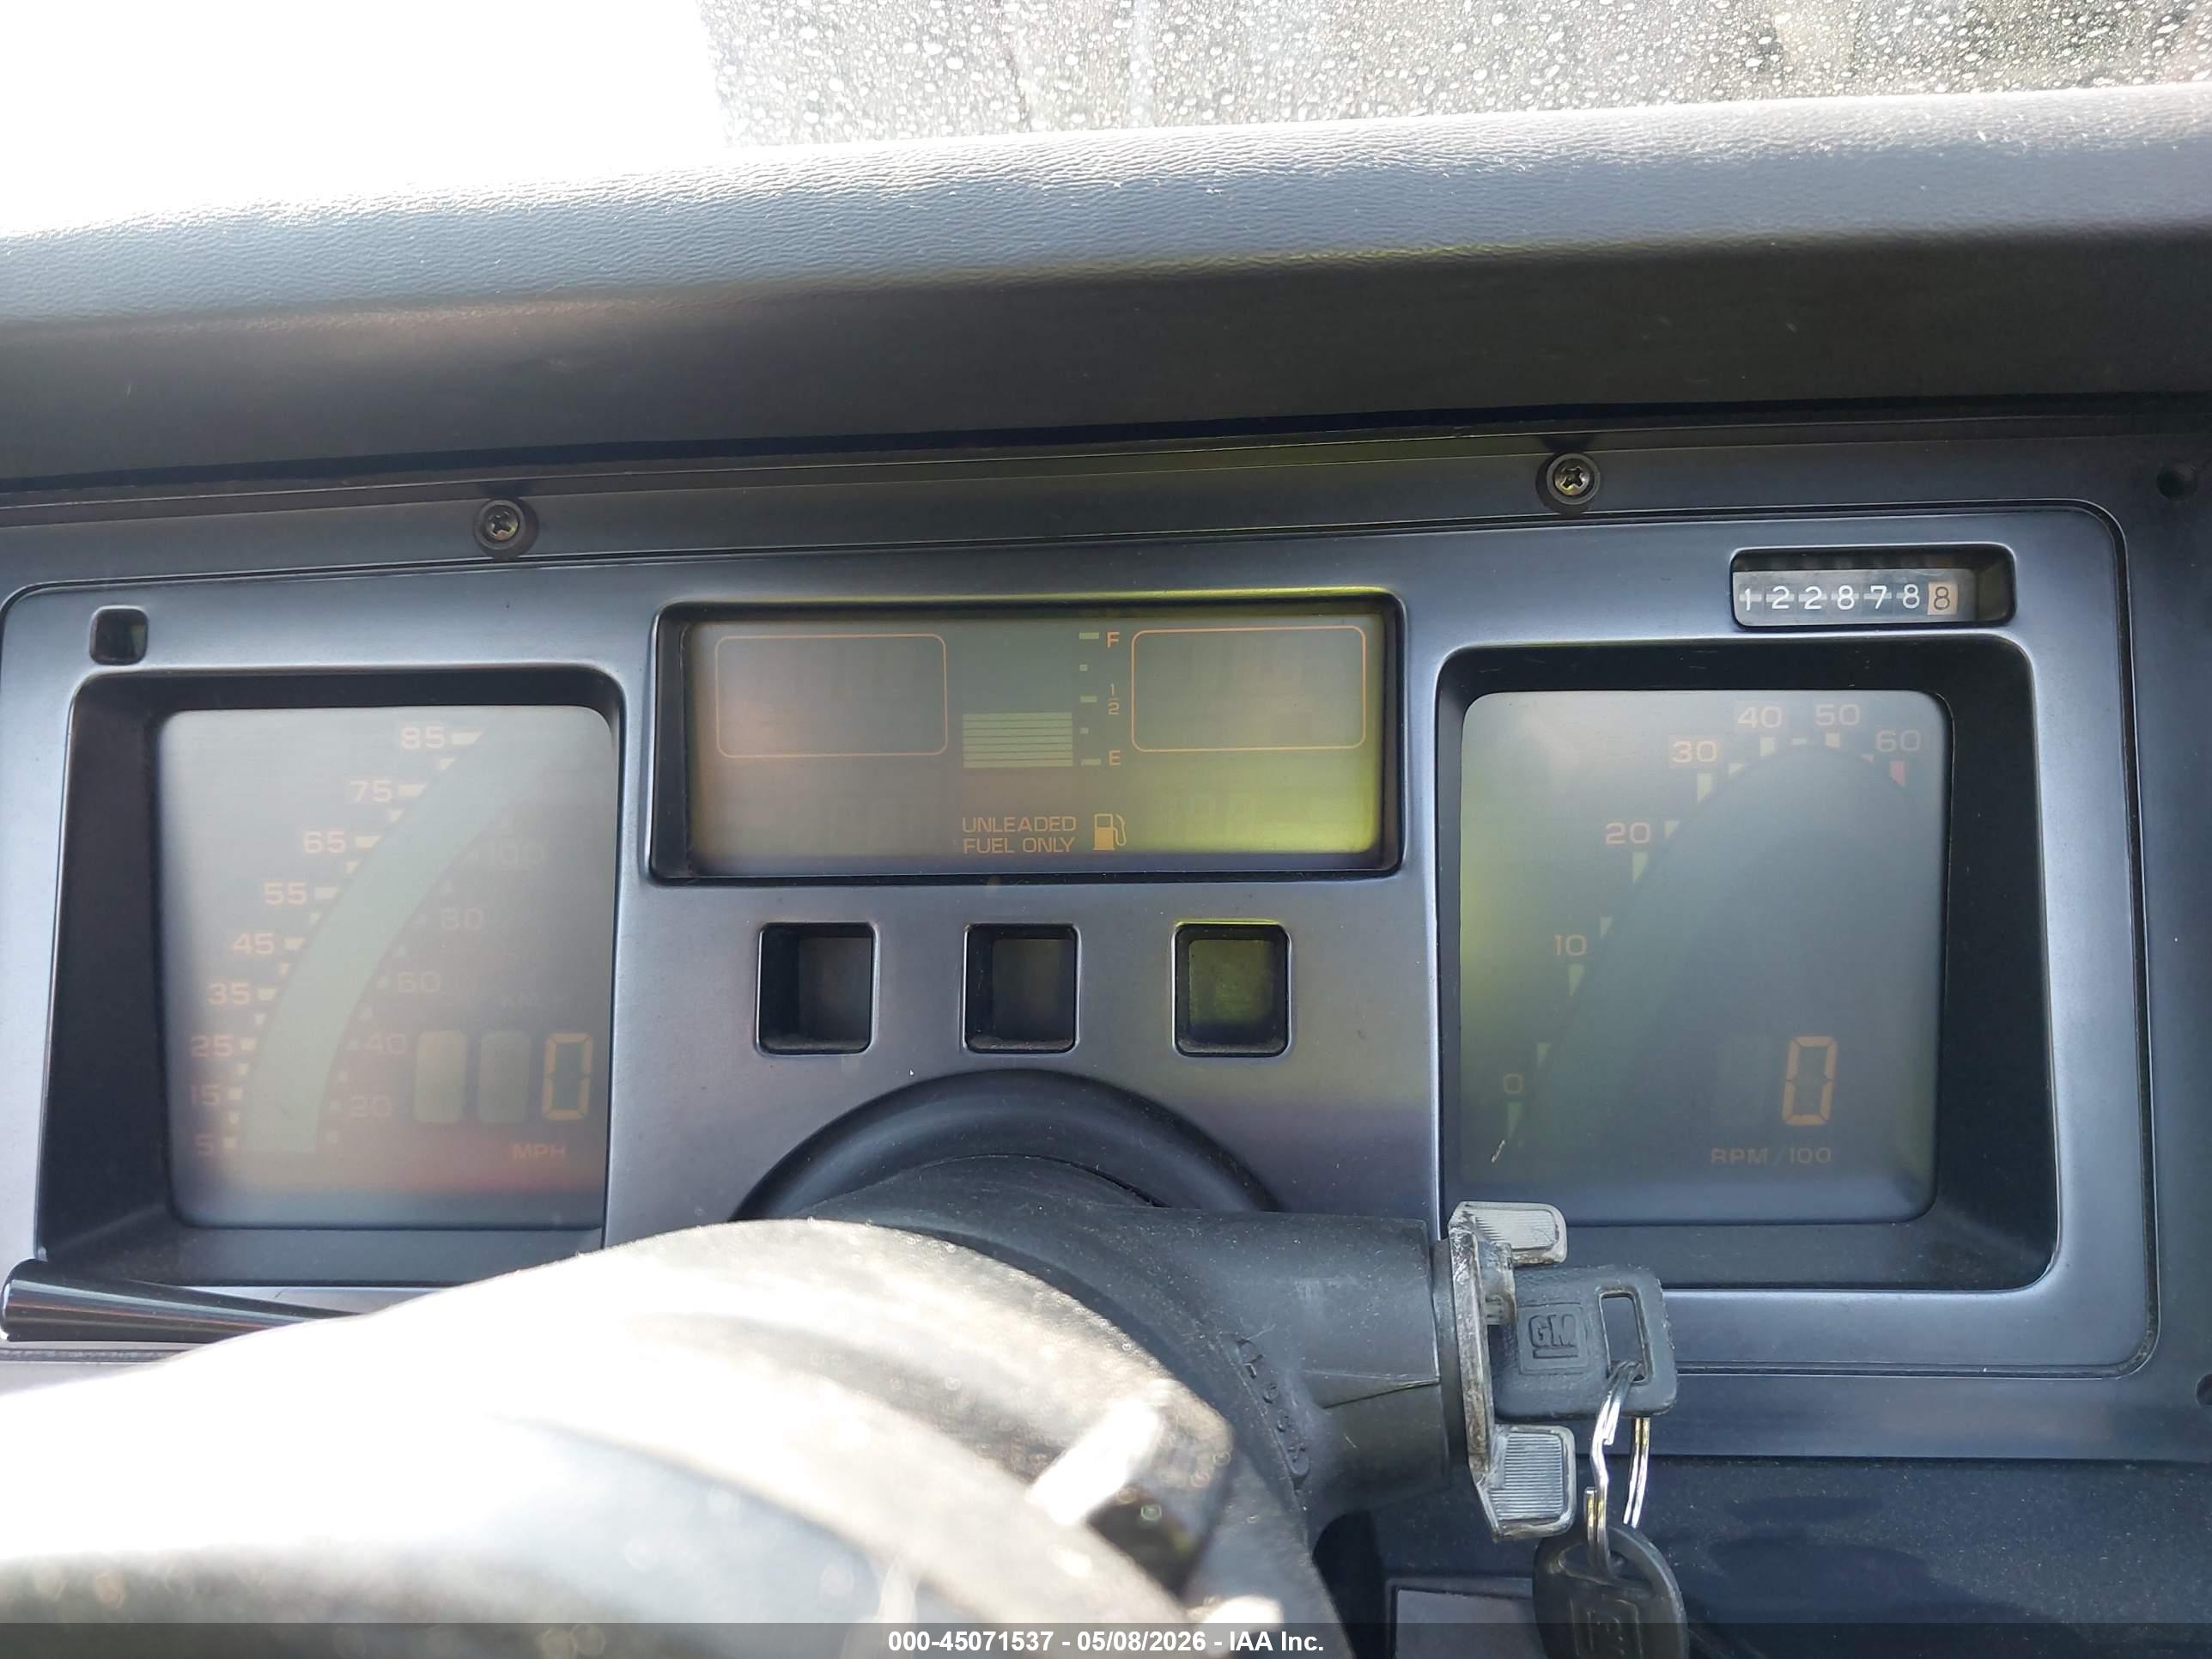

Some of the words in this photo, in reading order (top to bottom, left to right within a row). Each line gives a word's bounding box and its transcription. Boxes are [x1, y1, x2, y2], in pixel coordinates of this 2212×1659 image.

[1106, 631, 1121, 647] F
[1737, 706, 1784, 728] 40
[1814, 705, 1860, 726] 50
[401, 726, 446, 749] 85
[1875, 730, 1922, 753] 60
[1108, 750, 1121, 766] E
[1672, 740, 1717, 764] 30
[351, 781, 392, 802] 75
[962, 817, 1077, 833] UNLEADED
[1605, 823, 1651, 846] 20
[303, 831, 345, 853] 65
[963, 837, 1015, 854] FUEL
[1023, 836, 1075, 853] ONLY
[264, 882, 307, 905] 55
[232, 933, 275, 955] 45
[1554, 934, 1588, 957] 10
[208, 982, 251, 1005] 35
[191, 1036, 234, 1058] 25
[364, 1033, 407, 1055] 40
[541, 1032, 593, 1120] 0
[1503, 1073, 1522, 1095] 0
[1781, 1036, 1838, 1126] 0
[191, 1085, 221, 1106] 15
[193, 1133, 214, 1155] 5
[513, 1144, 567, 1161] MPH
[1528, 1313, 1577, 1347] GM
